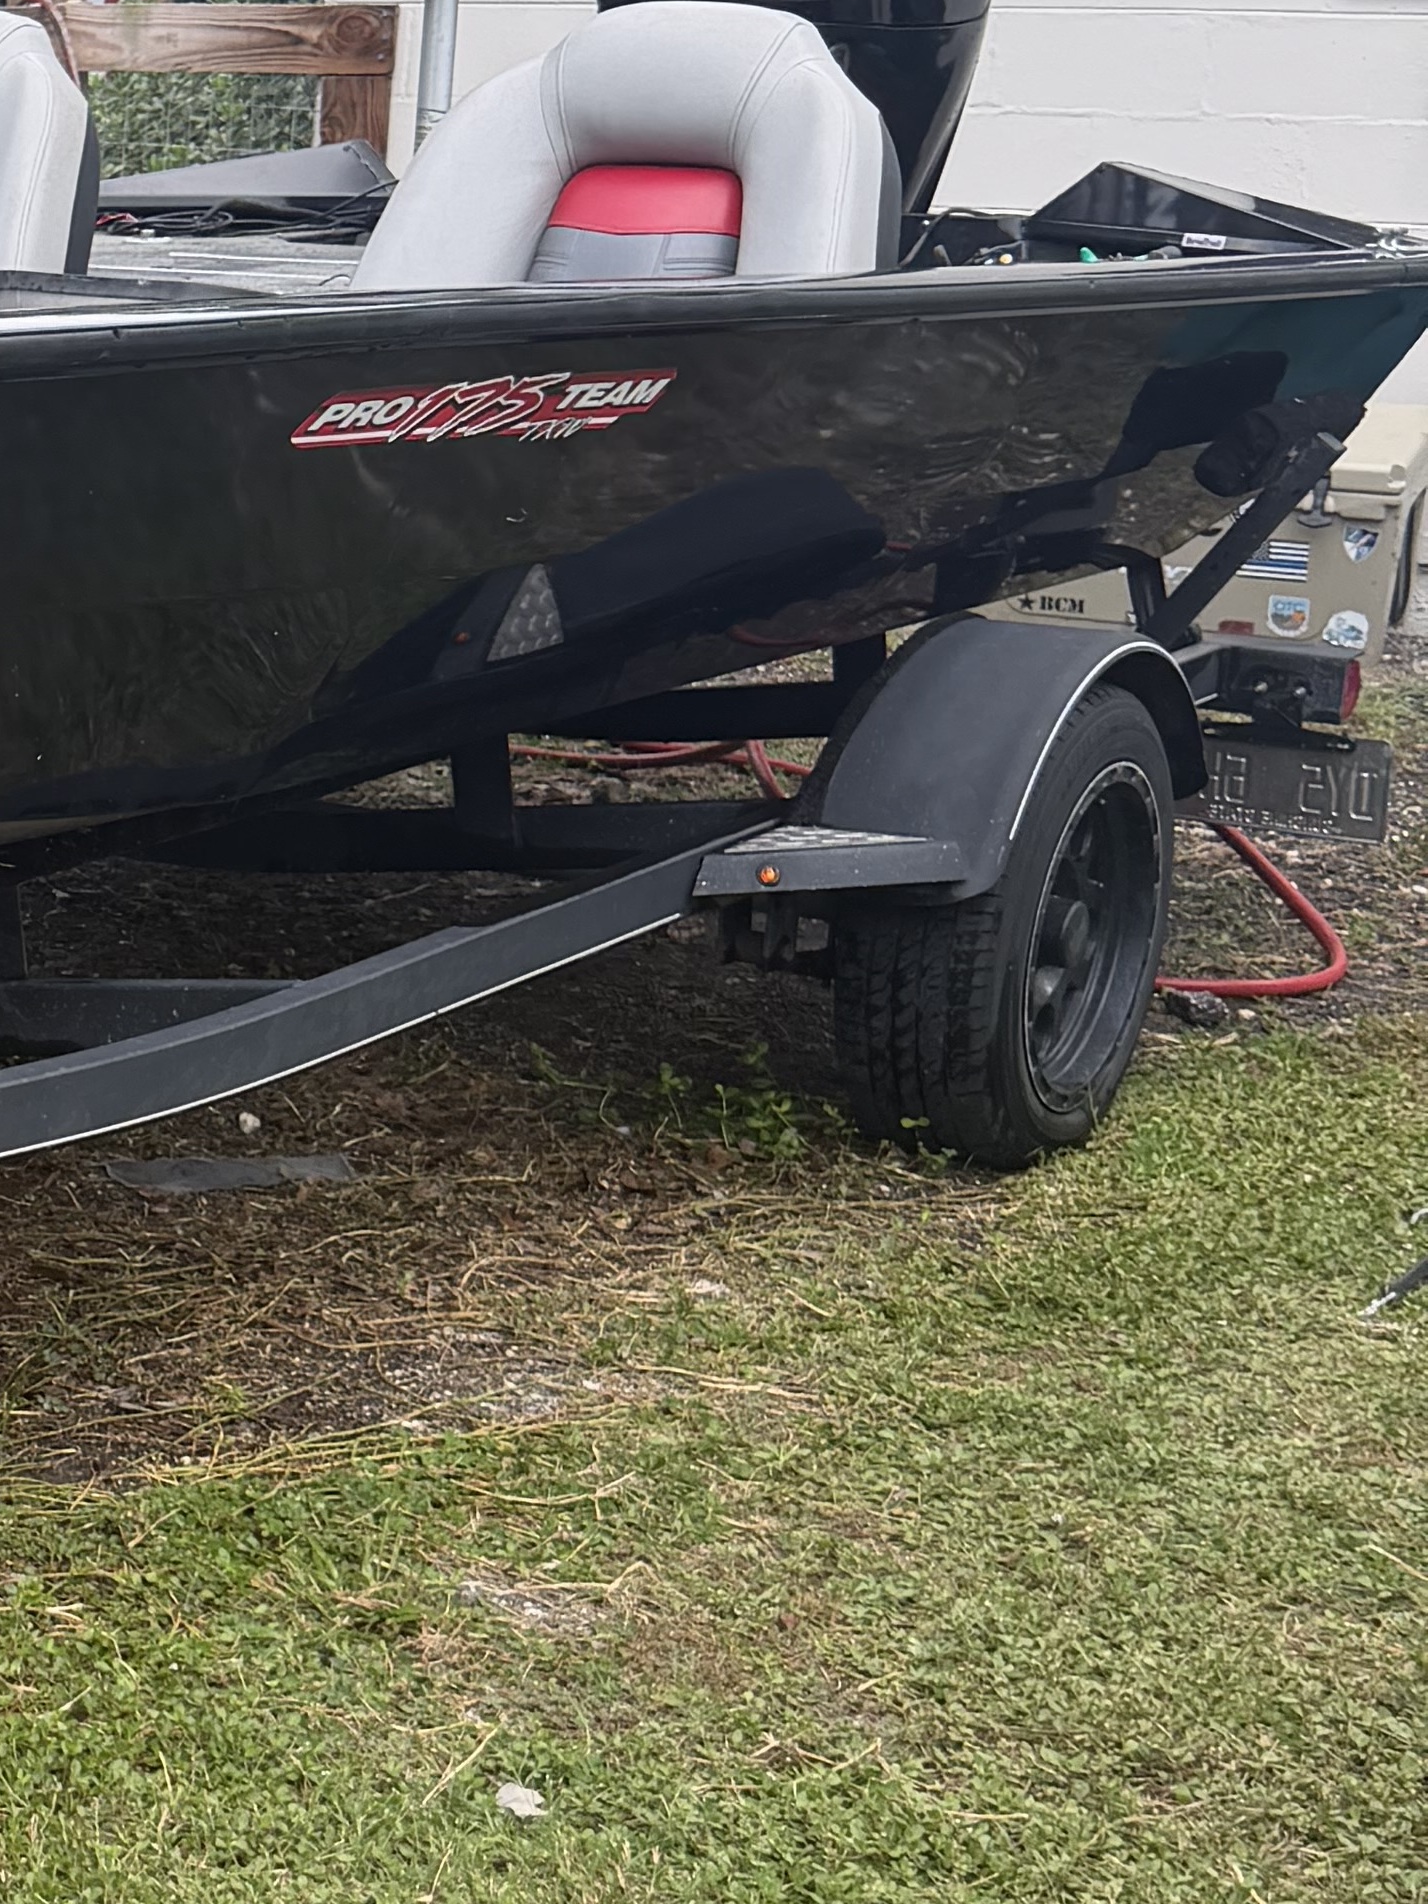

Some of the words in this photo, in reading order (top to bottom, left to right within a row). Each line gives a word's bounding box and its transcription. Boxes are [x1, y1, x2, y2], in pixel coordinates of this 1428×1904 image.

[308, 396, 413, 432] PRO
[389, 372, 572, 443] 175
[557, 378, 671, 410] TEAM
[1040, 596, 1085, 614] BCM
